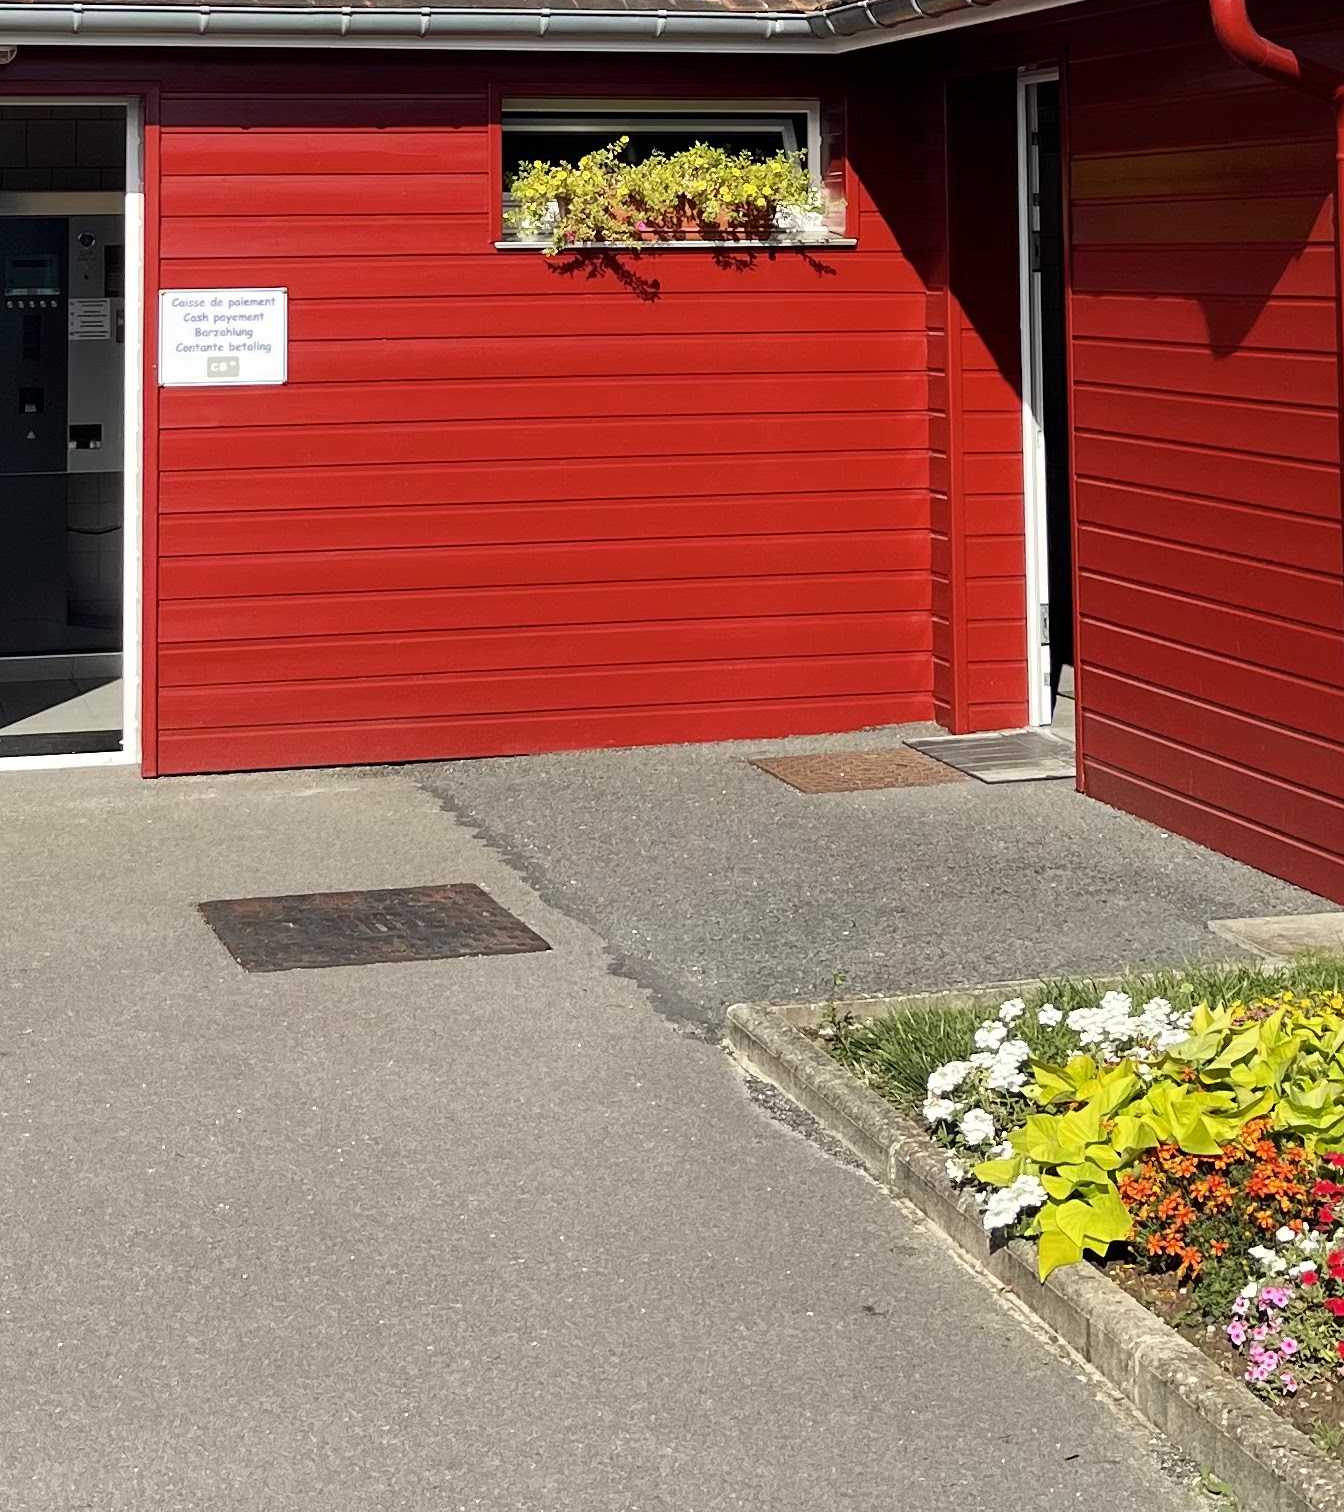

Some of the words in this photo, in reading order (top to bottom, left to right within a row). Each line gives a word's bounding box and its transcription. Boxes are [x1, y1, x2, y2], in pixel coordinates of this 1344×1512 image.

[172, 298, 205, 307] Caisse
[210, 298, 223, 307] de
[228, 297, 276, 308] paiement
[184, 313, 208, 322] Cash
[214, 313, 264, 324] payement
[195, 328, 253, 339] Barzahlung
[176, 343, 224, 352] Contante
[229, 342, 271, 353] betaling
[210, 363, 228, 372] CB
